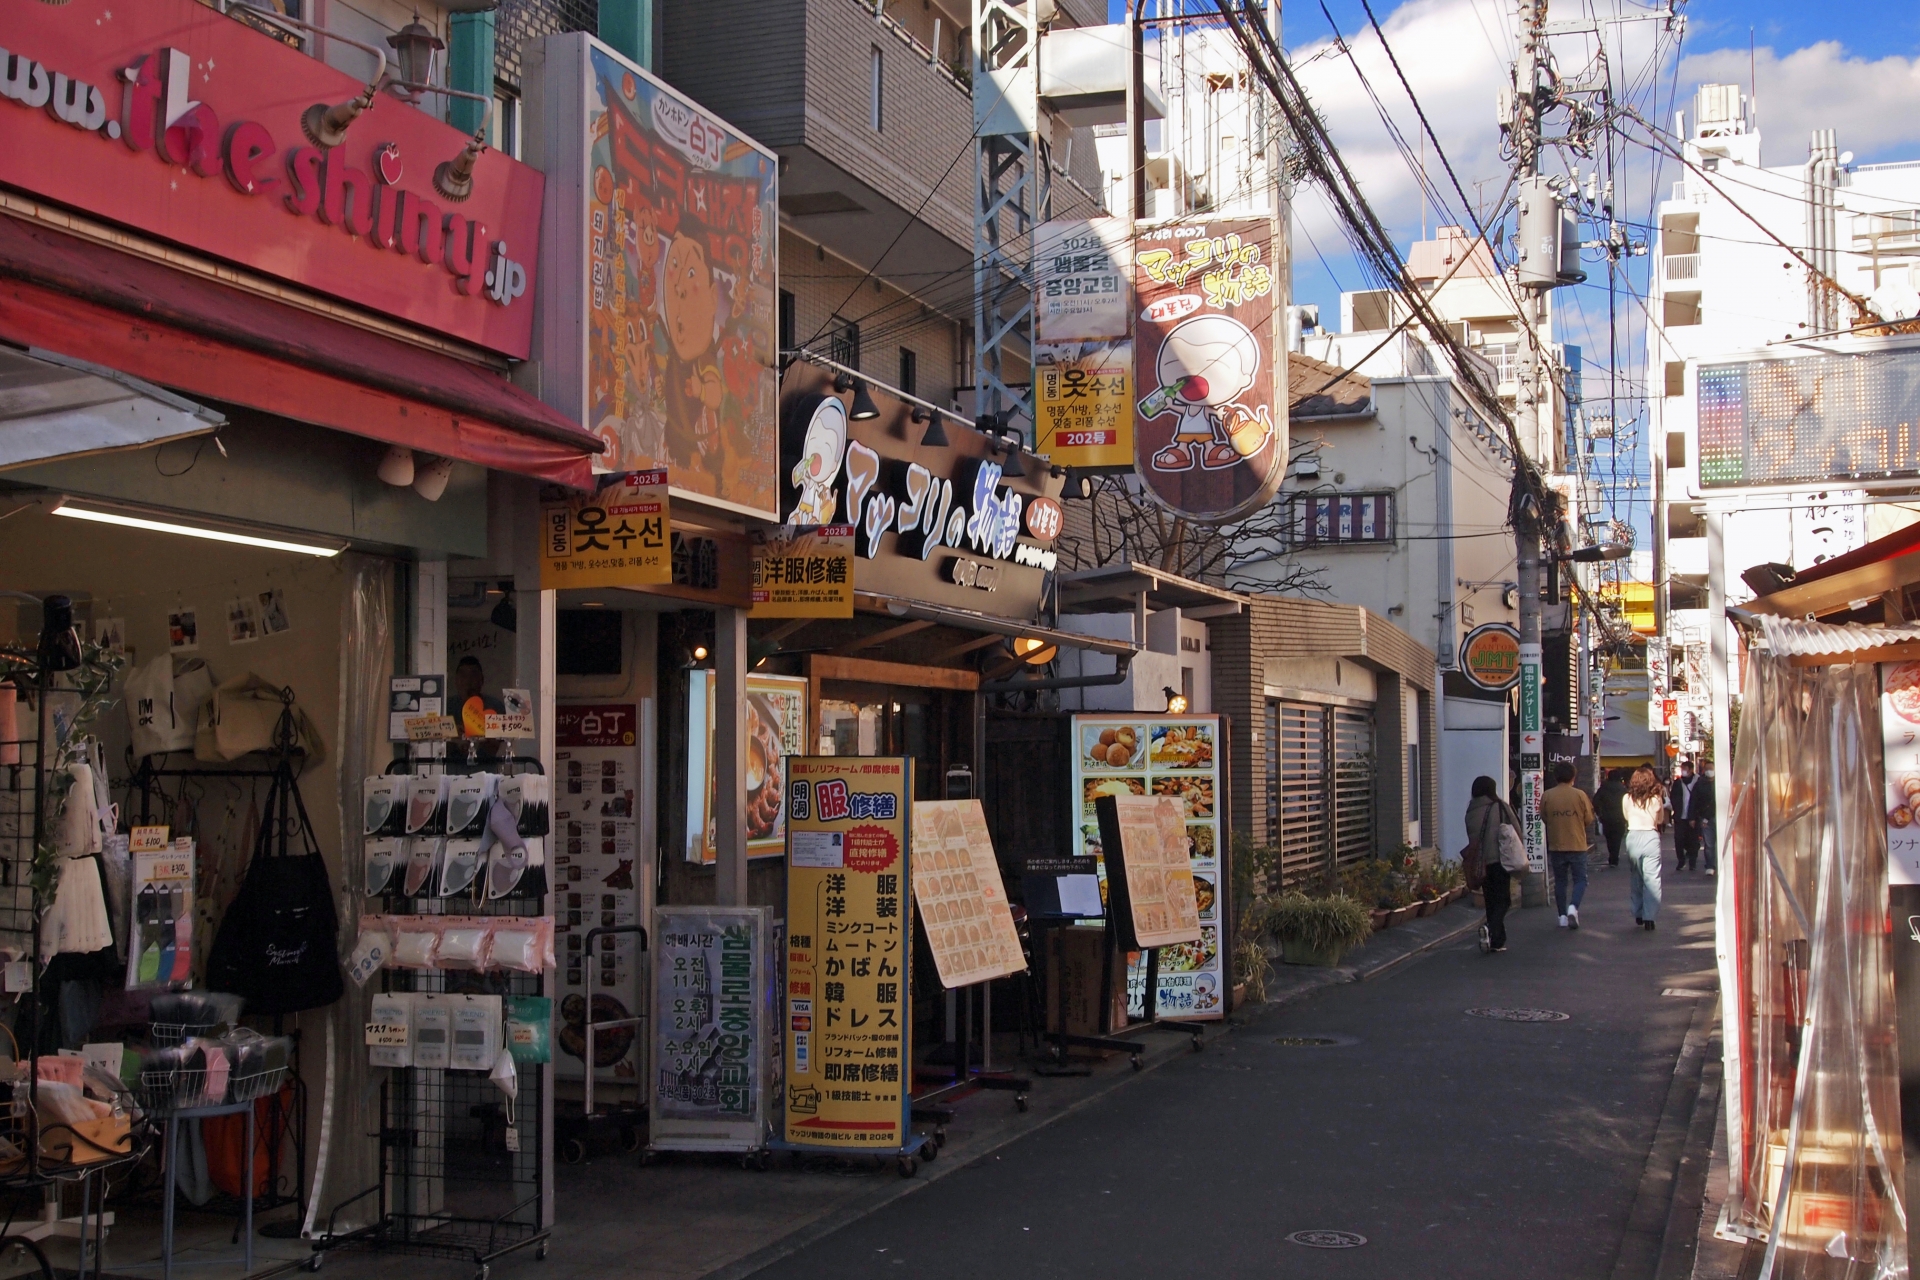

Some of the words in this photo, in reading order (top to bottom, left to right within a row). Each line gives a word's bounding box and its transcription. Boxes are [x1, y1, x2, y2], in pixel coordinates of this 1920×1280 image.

[690, 114, 725, 163] 白丁
[1136, 233, 1261, 289] マッコリの
[1045, 276, 1119, 298] 중앙교회
[1202, 265, 1273, 309] 物語
[1046, 373, 1058, 398] 명동
[1061, 369, 1126, 398] 옷수선
[1046, 406, 1066, 417] 명품
[1094, 403, 1122, 415] 옷수선
[1053, 418, 1072, 429] 맞춤
[1075, 416, 1094, 427] 리폼
[1096, 415, 1116, 427] 수선
[1067, 432, 1106, 445] 202号
[633, 474, 660, 485] 202号
[846, 440, 965, 560] マッコリの
[966, 460, 1022, 560] 物語
[552, 513, 567, 552] 명동
[574, 506, 664, 553] 옷수선
[824, 527, 848, 537] 202号
[553, 561, 568, 571] 명품
[628, 557, 643, 567] 리폼
[645, 556, 659, 566] 수선
[764, 555, 847, 584] 洋服修繕
[1471, 650, 1519, 668] JMT
[1524, 664, 1535, 731] 畑中ケアサービス
[138, 717, 154, 726] OK
[581, 711, 627, 736] 白丁
[1548, 752, 1576, 764] Uber
[792, 781, 810, 820] 明洞
[815, 779, 898, 822] 服修繕
[825, 873, 898, 896] 洋服
[825, 896, 898, 918] 洋装
[826, 921, 899, 935] ミンクコート
[665, 933, 714, 949] 예배시간
[789, 935, 812, 949] 格種
[825, 938, 898, 953] ムートン
[673, 957, 706, 973] 오전
[789, 967, 812, 976] リフォーム
[825, 956, 899, 978] かばん
[673, 974, 706, 989] 11시
[789, 981, 812, 995] 修繕
[825, 981, 898, 1003] 韓服
[1159, 989, 1194, 1009] 物語
[673, 999, 707, 1014] 오후
[794, 1003, 809, 1011] VISA
[675, 1016, 701, 1031] 2시
[825, 1007, 898, 1028] ドレス
[366, 1025, 387, 1034] マスク
[664, 1040, 712, 1057] 수요일
[825, 1046, 898, 1059] リフォーム修繕
[674, 1057, 701, 1074] 3시
[824, 1062, 899, 1083] 即席修繕
[692, 1086, 716, 1100] 302호
[869, 1132, 894, 1142] 202号
